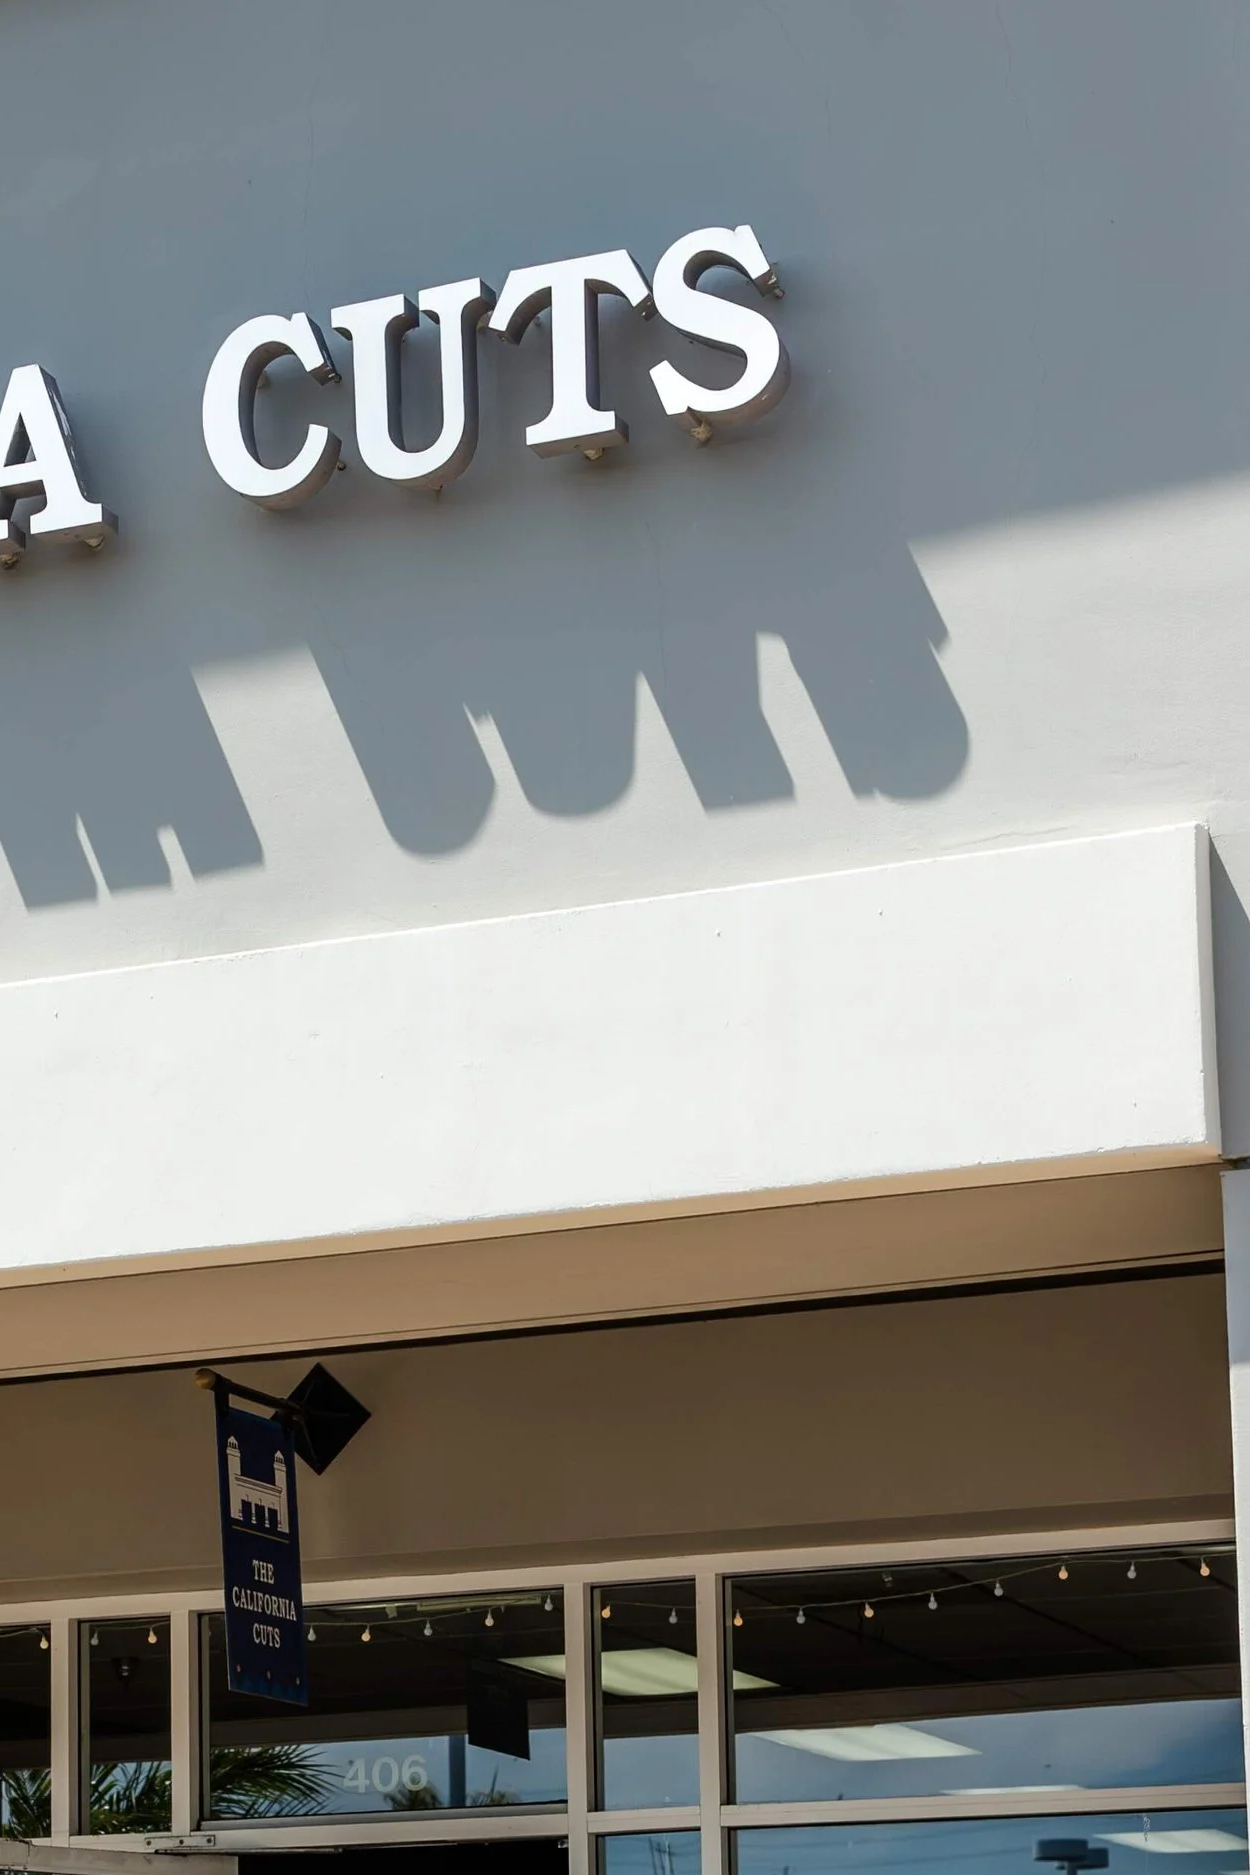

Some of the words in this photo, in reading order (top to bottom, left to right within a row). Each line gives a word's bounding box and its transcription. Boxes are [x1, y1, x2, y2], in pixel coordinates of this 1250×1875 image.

[202, 224, 788, 505] CUTS
[252, 1559, 275, 1584] THE
[232, 1586, 297, 1621] CALIFORNIA
[253, 1623, 281, 1648] CUTS
[343, 1755, 427, 1793] 406
